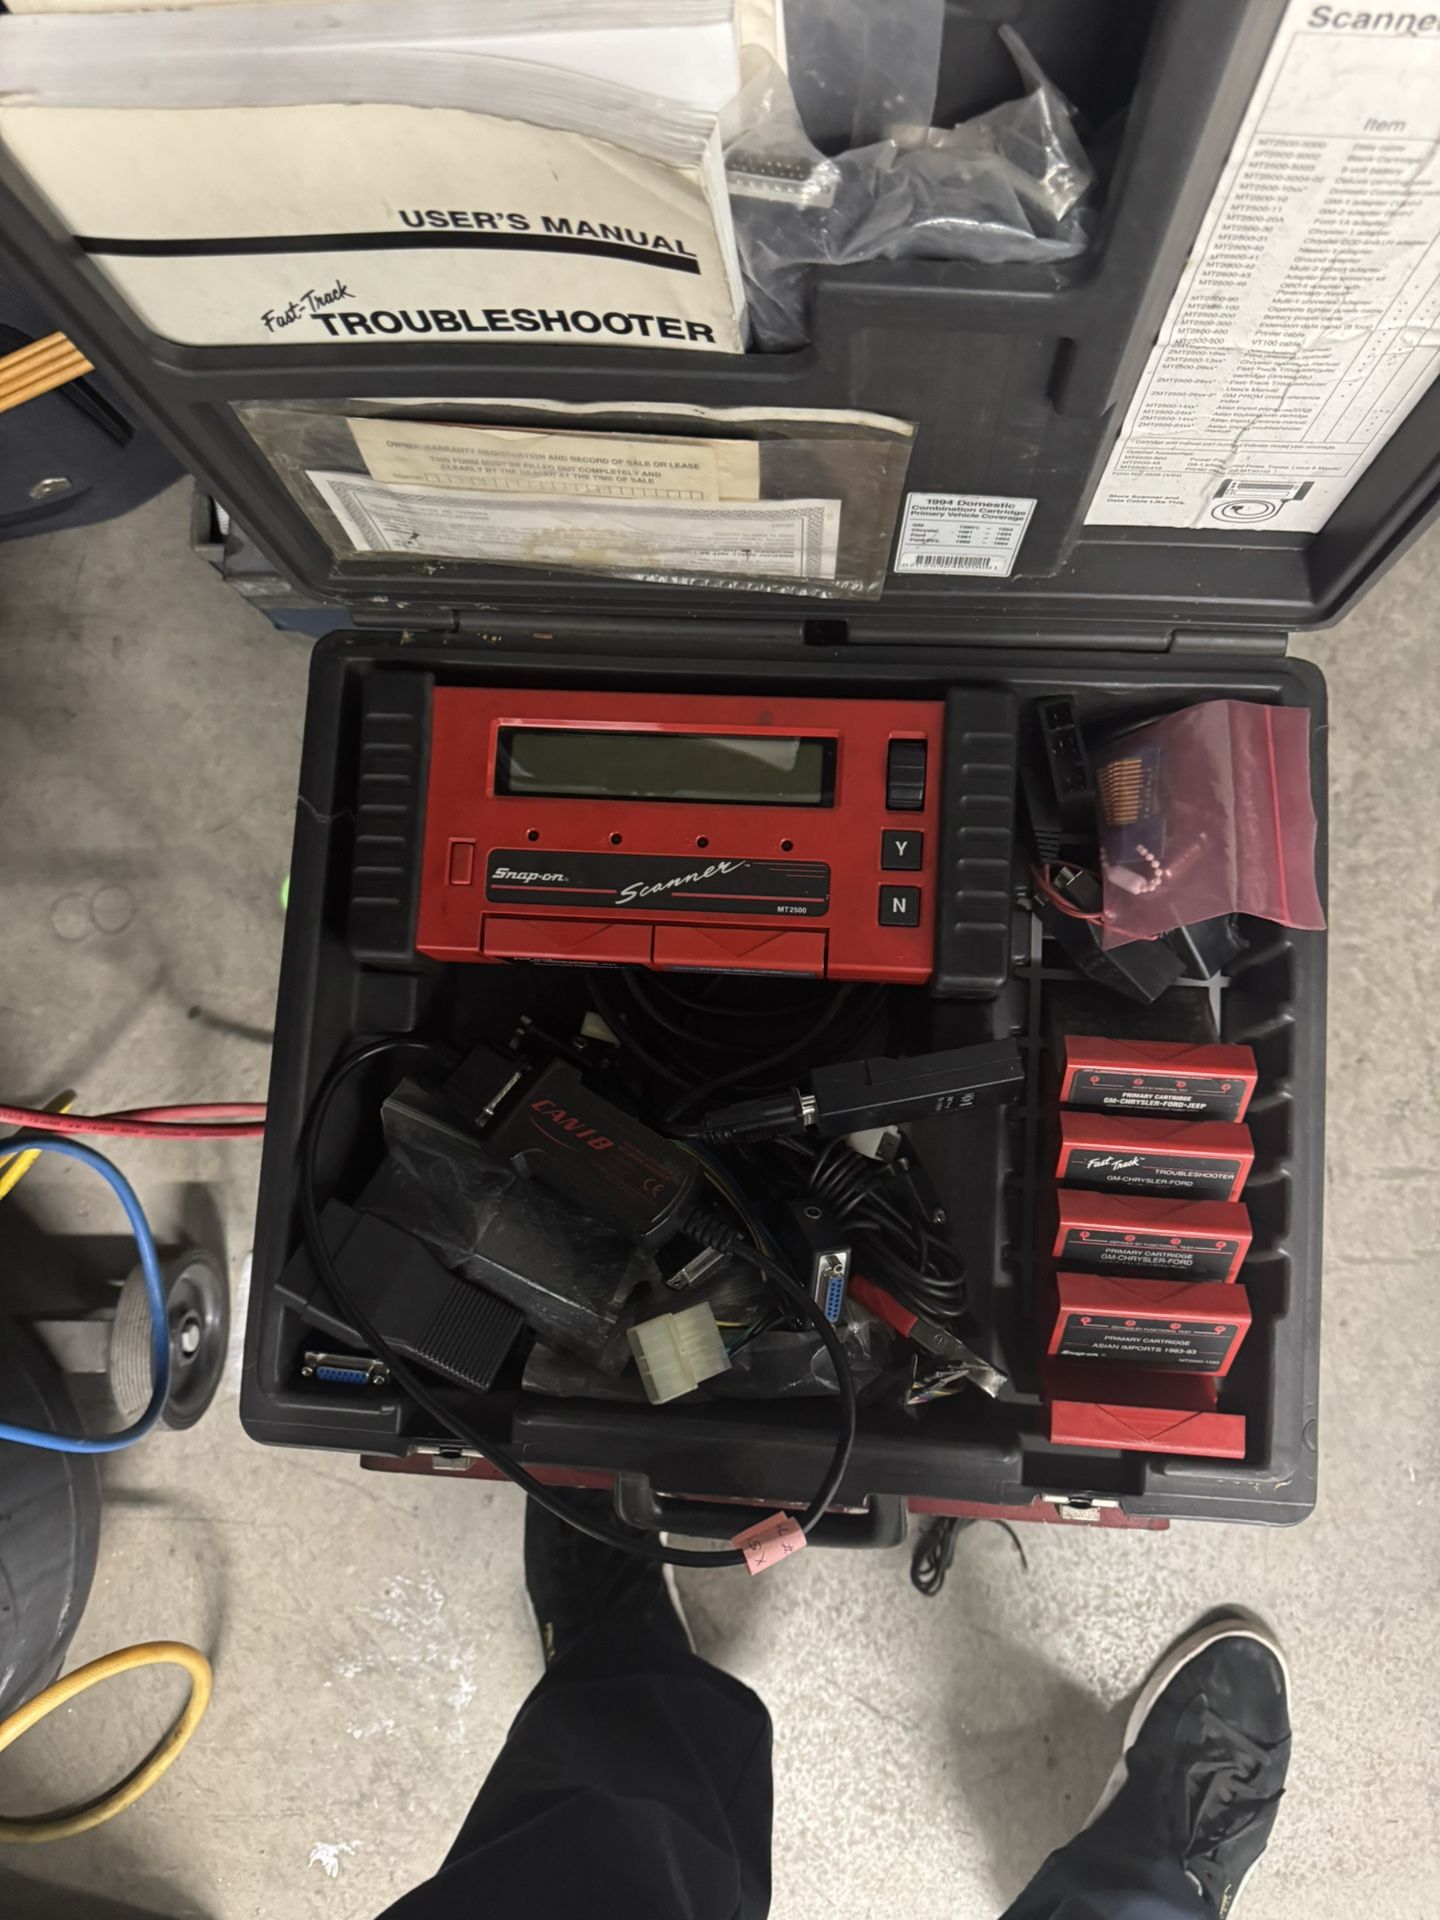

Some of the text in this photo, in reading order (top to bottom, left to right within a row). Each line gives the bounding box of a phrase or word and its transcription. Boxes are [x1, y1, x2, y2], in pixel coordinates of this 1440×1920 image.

[1307, 4, 1440, 32] Scanne
[1363, 117, 1407, 133] Item
[398, 209, 698, 258] USER'S MANUAL
[260, 279, 356, 333] Fast-Track
[310, 308, 716, 344] TROUBLESHOOTER
[1252, 339, 1278, 347] VT100
[548, 454, 568, 462] AND
[569, 456, 610, 465] RECORD
[611, 458, 624, 466] OF
[626, 459, 651, 468] SALE
[652, 461, 667, 469] OR
[668, 461, 701, 471] LEASE
[577, 466, 641, 477] COMPLETELY
[642, 471, 662, 479] AND
[630, 478, 655, 486] SALE
[911, 504, 1027, 517] Combination Cartridge
[926, 499, 1016, 510] 1994 Domestic
[910, 510, 1025, 523] Primary Vehicle Coverage
[894, 840, 909, 857] Y
[492, 866, 565, 884] Snap-on
[615, 860, 747, 905] Scanner
[777, 903, 809, 915] MT2500
[892, 897, 907, 913] N
[1103, 1097, 1207, 1110] GM-CHRYSLER-FORD-JEEP
[1121, 1092, 1193, 1102] PRIMARY CARTRIDGE
[1087, 1155, 1142, 1171] Fast Track
[1154, 1168, 1235, 1180] TROUBLESHOOTER
[1106, 1175, 1195, 1187] GM-CHRYSLER-FORD
[1105, 1247, 1194, 1259] PRIMARY CARTRIDGE
[1100, 1254, 1194, 1266] GM-CHRYSLER-FORD
[1091, 1342, 1120, 1350] ASIAN
[1120, 1345, 1162, 1353] IMPORTS
[1104, 1335, 1191, 1347] PRIMARY CARTRIDGE
